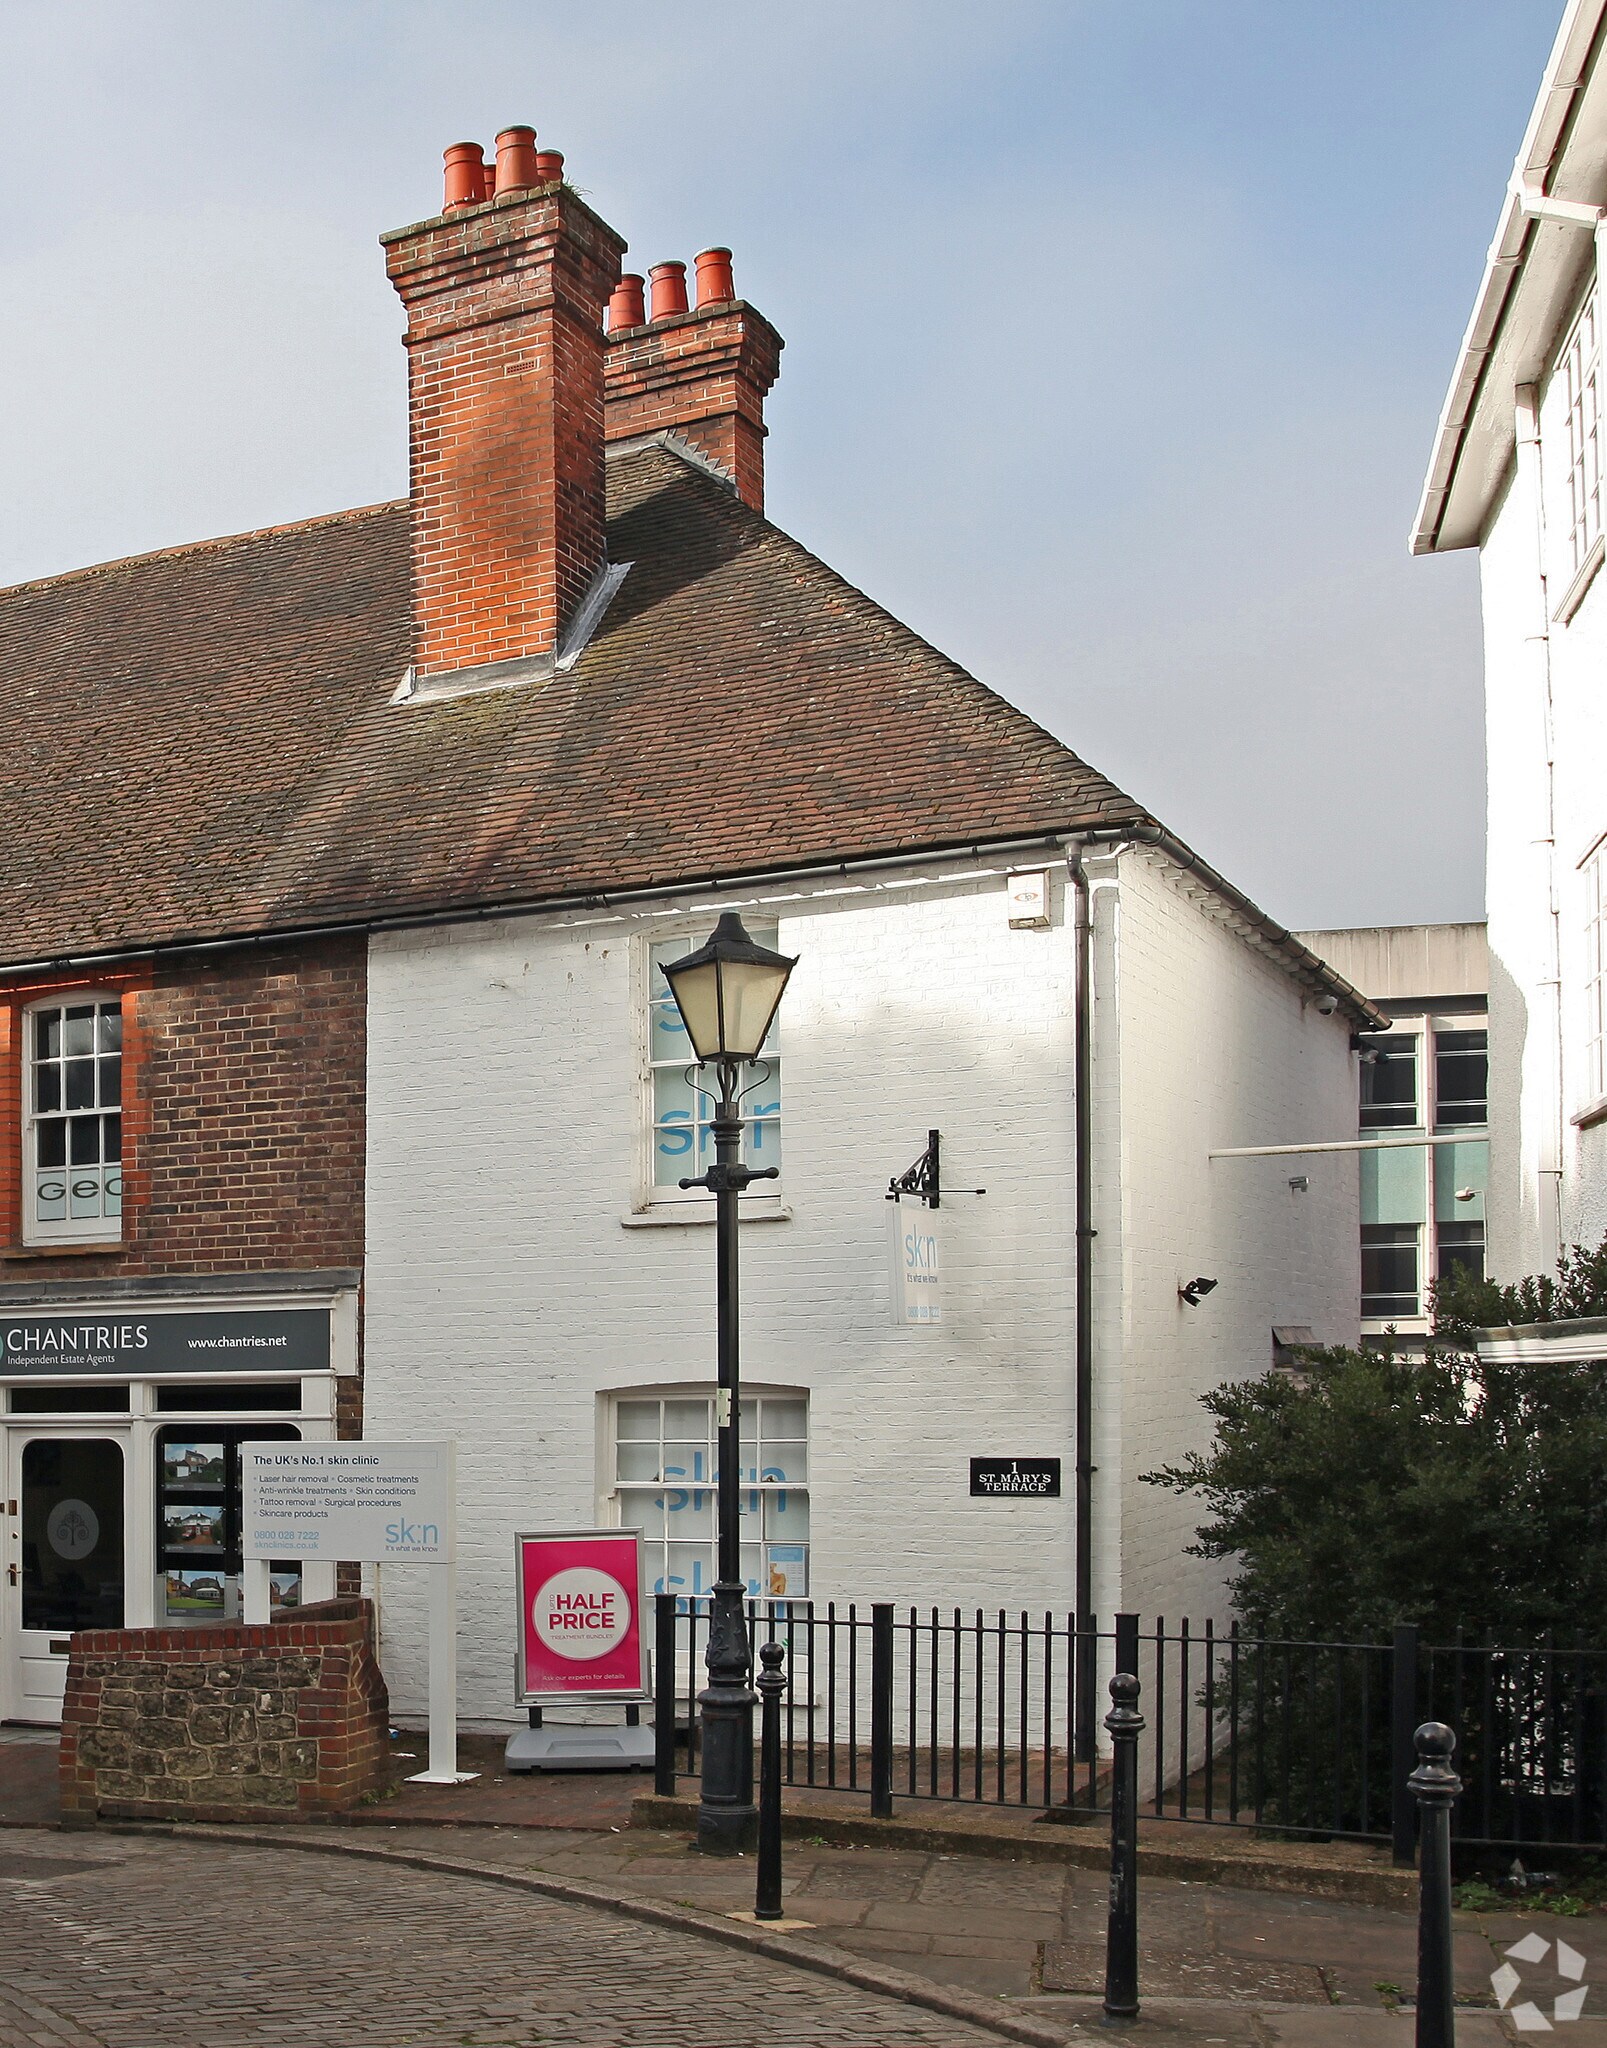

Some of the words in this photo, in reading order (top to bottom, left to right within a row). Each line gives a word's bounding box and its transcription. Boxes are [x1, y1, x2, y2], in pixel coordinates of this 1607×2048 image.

[6, 1325, 149, 1351] CHANTRIES
[187, 1335, 288, 1348] www.chantries.net
[7, 1354, 59, 1367] Independent
[60, 1353, 85, 1364] Estate
[86, 1354, 115, 1367] Agents
[253, 1455, 272, 1465] The
[275, 1455, 299, 1465] UK's
[301, 1455, 325, 1465] No.1
[327, 1455, 349, 1465] skin
[351, 1455, 380, 1465] clinic
[1011, 1461, 1019, 1474] 1
[259, 1475, 280, 1483] Laser
[281, 1475, 297, 1483] hair
[298, 1475, 329, 1483] removal
[337, 1475, 375, 1483] Cosmetic
[376, 1475, 419, 1484] treatments
[979, 1473, 996, 1483] ST
[1000, 1472, 1052, 1484] MARY'S
[259, 1486, 305, 1495] Anti-wrinkle
[305, 1487, 347, 1495] treatments
[355, 1486, 373, 1495] Skin
[374, 1487, 416, 1496] conditions
[984, 1482, 1047, 1492] TERRACE
[259, 1497, 284, 1506] Tattoo
[285, 1497, 317, 1506] removal
[324, 1498, 356, 1508] Surgical
[357, 1499, 402, 1508] procedures
[259, 1509, 293, 1517] Skincare
[294, 1509, 329, 1519] products
[254, 1530, 276, 1540] 0800
[297, 1531, 320, 1540] 7222
[385, 1517, 438, 1544] sk:n
[556, 1593, 615, 1610] HALF
[549, 1612, 616, 1630] PRICE
